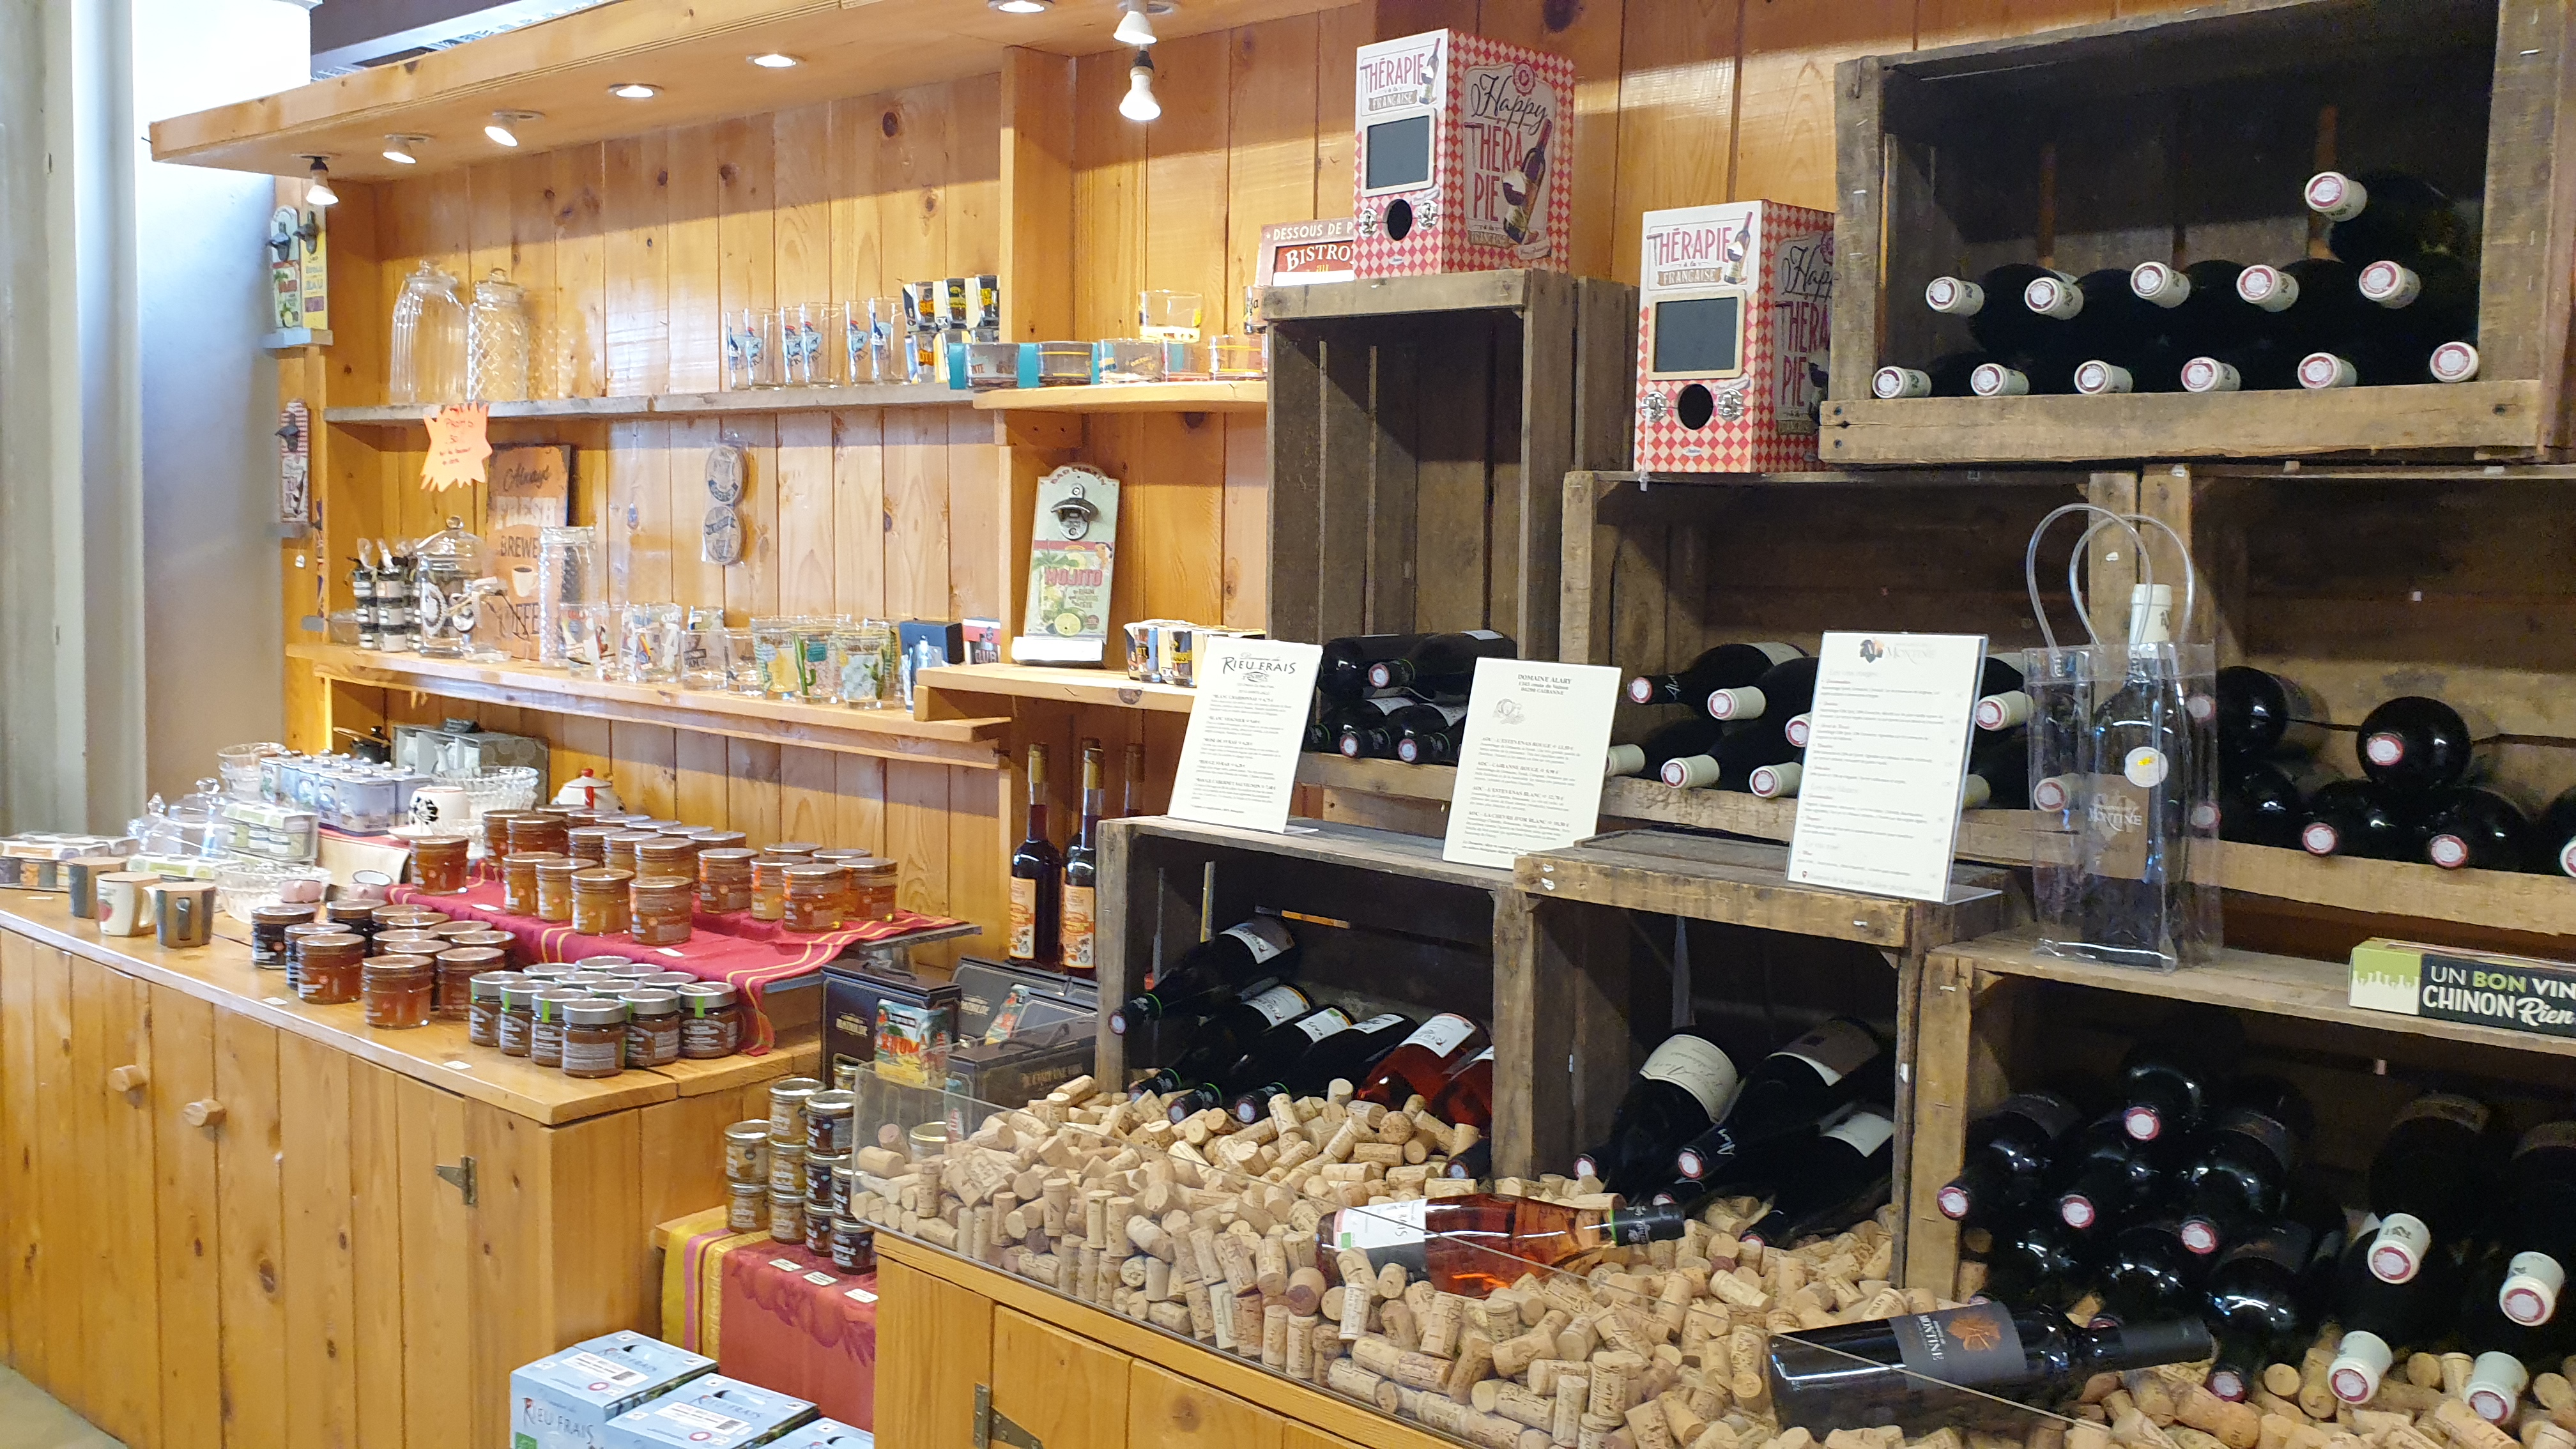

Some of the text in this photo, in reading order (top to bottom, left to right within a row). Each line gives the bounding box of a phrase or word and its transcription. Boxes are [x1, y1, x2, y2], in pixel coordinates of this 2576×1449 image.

[1360, 53, 1425, 94] THÉRAPIE
[1470, 73, 1549, 135] Happy
[1474, 172, 1499, 222] PIE
[1273, 224, 1322, 241] DESSOUS
[1328, 223, 1342, 235] DE
[1646, 226, 1733, 266] THÉRAPIE
[1285, 244, 1351, 272] BISTRO
[1781, 245, 1833, 303] Happ
[1782, 355, 1808, 407] PIE
[494, 496, 558, 531] FRESH
[500, 535, 539, 558] BREWE
[1221, 656, 1297, 675] RIEU FRAIS
[2430, 965, 2576, 1000] UN BON VIN
[2422, 985, 2576, 1027] CHINON Rien
[557, 1415, 594, 1445] FRAIS
